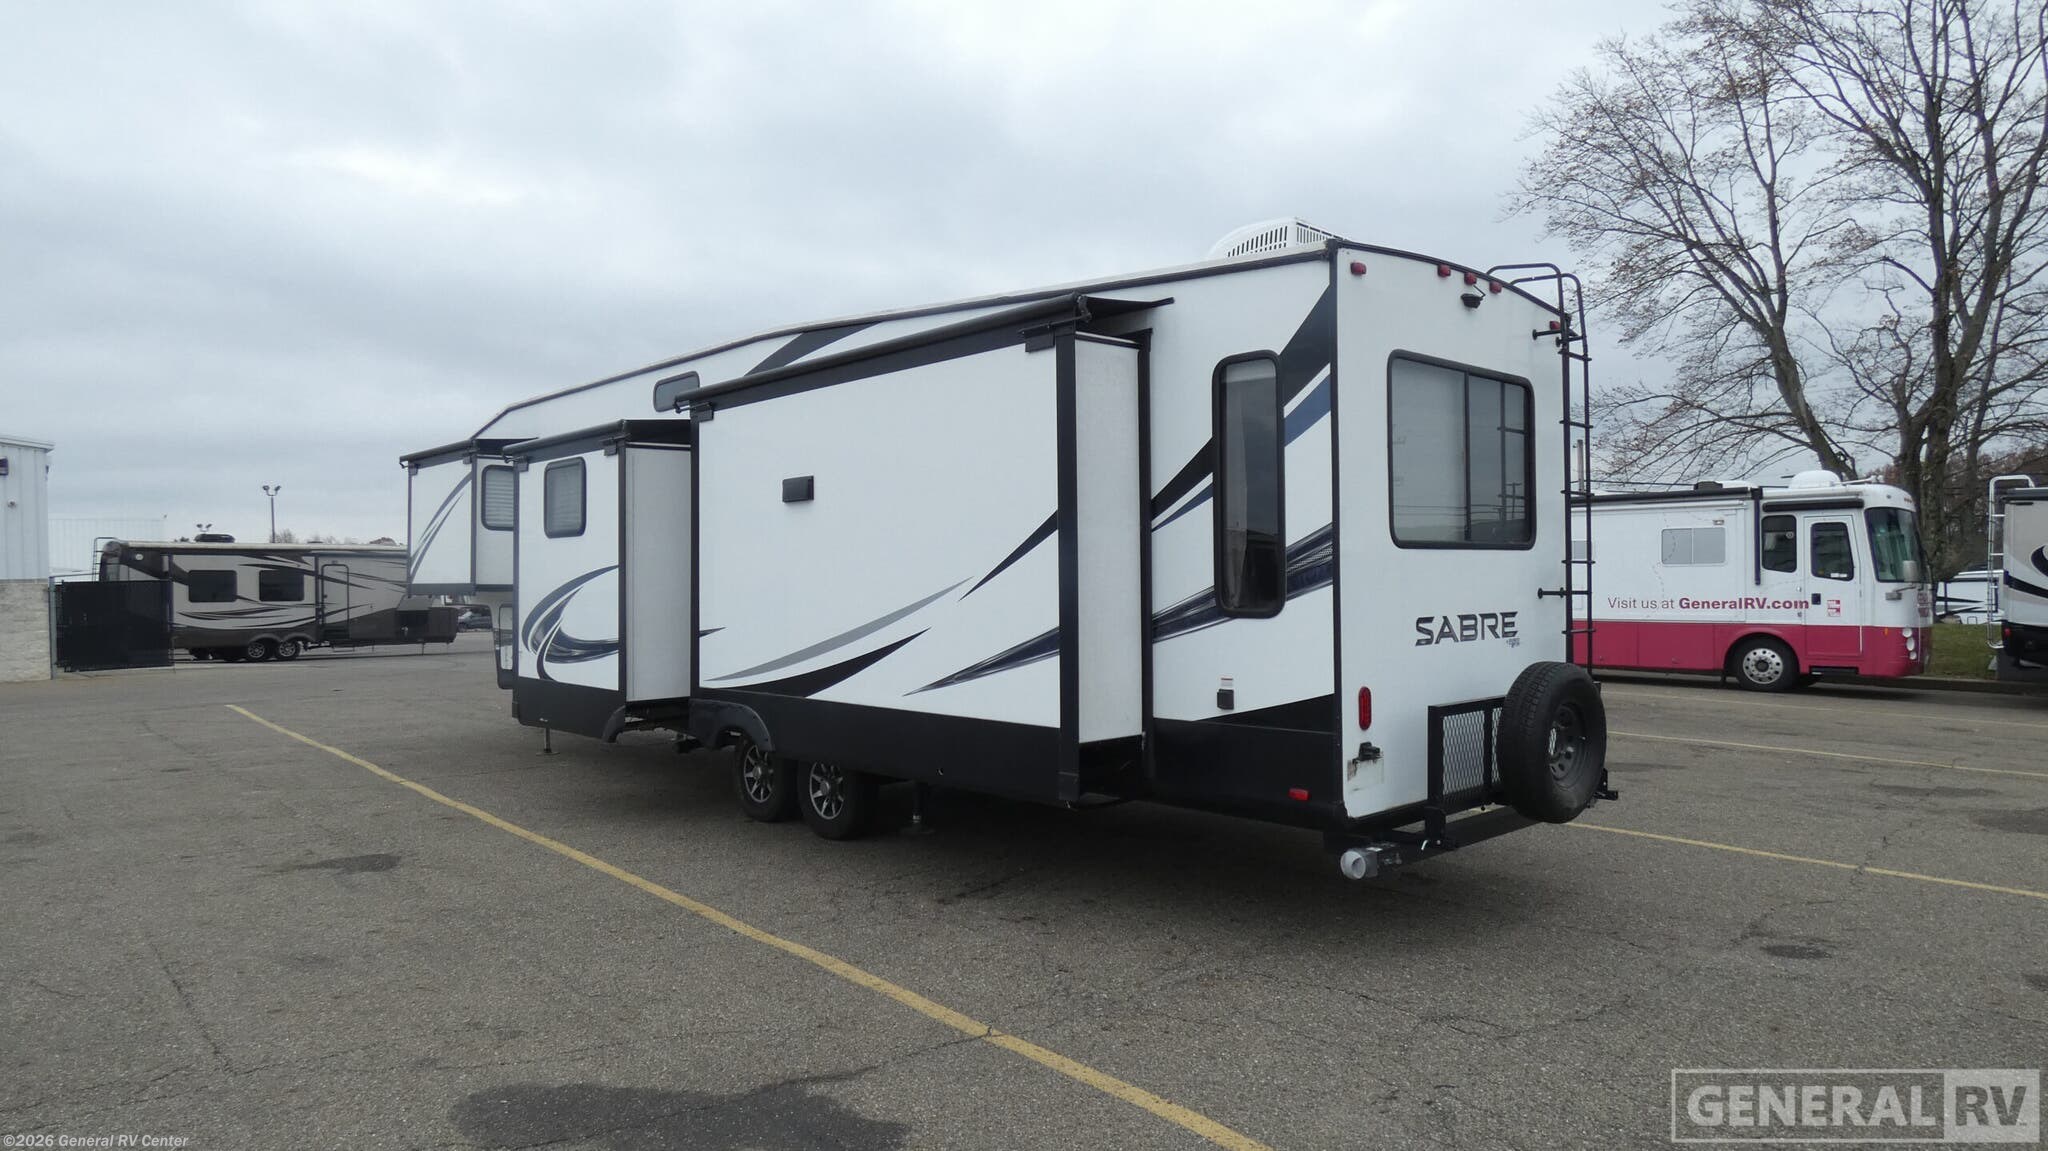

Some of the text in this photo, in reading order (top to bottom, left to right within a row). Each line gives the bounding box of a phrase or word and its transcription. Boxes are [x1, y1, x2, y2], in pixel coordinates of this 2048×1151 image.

[1607, 597, 1810, 610] Visit us at GeneralRV.com
[1415, 611, 1519, 646] SABRE
